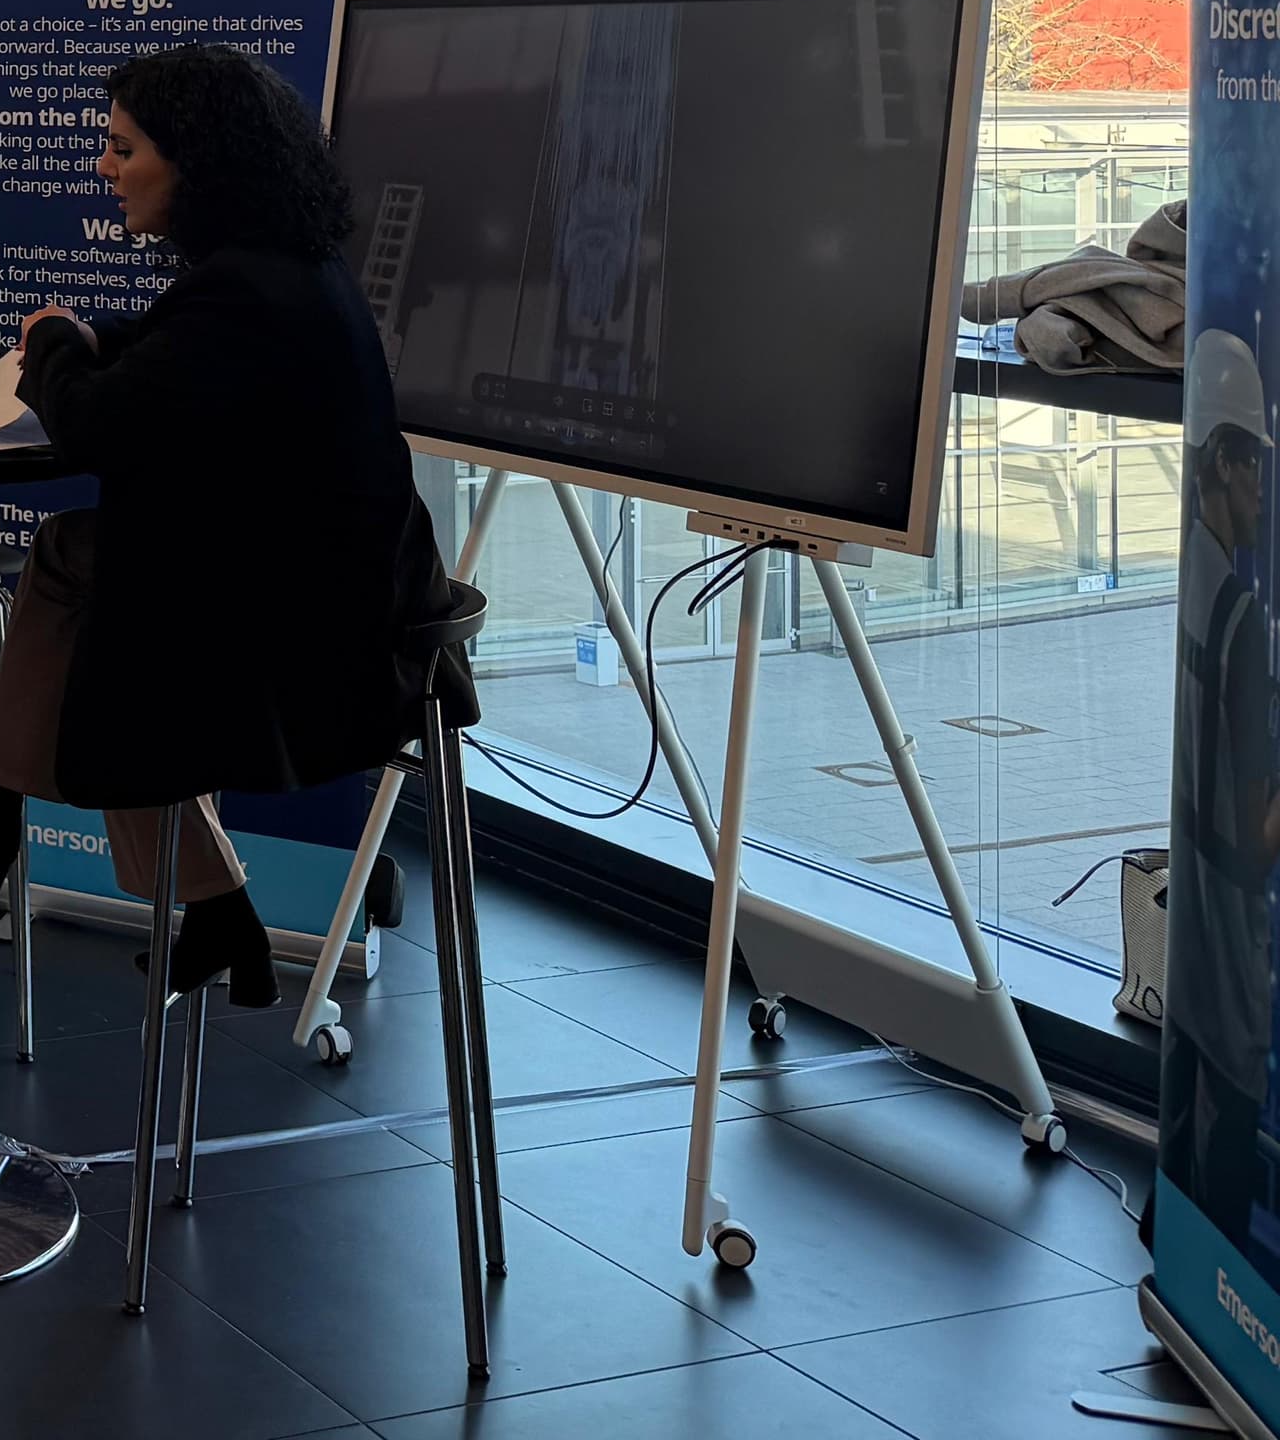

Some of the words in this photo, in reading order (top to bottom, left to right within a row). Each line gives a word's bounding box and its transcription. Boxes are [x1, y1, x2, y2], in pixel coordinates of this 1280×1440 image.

[19, 20, 29, 33] a
[32, 16, 85, 33] choice
[101, 16, 122, 33] it's
[125, 19, 146, 32] an
[150, 16, 208, 36] engine
[212, 15, 247, 32] that
[250, 14, 304, 32] drives
[64, 38, 132, 55] Because
[134, 41, 160, 55] we
[266, 38, 296, 55] the
[42, 60, 75, 77] that
[8, 86, 33, 98] we
[36, 86, 59, 103] go
[1216, 68, 1257, 101] from
[38, 107, 77, 127] the
[80, 108, 111, 128] flo
[36, 136, 65, 149] out
[68, 134, 95, 150] the
[21, 155, 39, 171] all
[43, 155, 71, 172] the
[2, 176, 62, 198] change
[65, 179, 101, 195] with
[81, 217, 124, 242] We
[2, 242, 67, 262] intuitive
[70, 246, 141, 266] software
[8, 266, 32, 282] for
[35, 267, 131, 290] themselves,
[44, 291, 90, 308] share
[94, 294, 127, 310] that
[0, 503, 34, 523] The
[1217, 1266, 1280, 1370] Emerso
